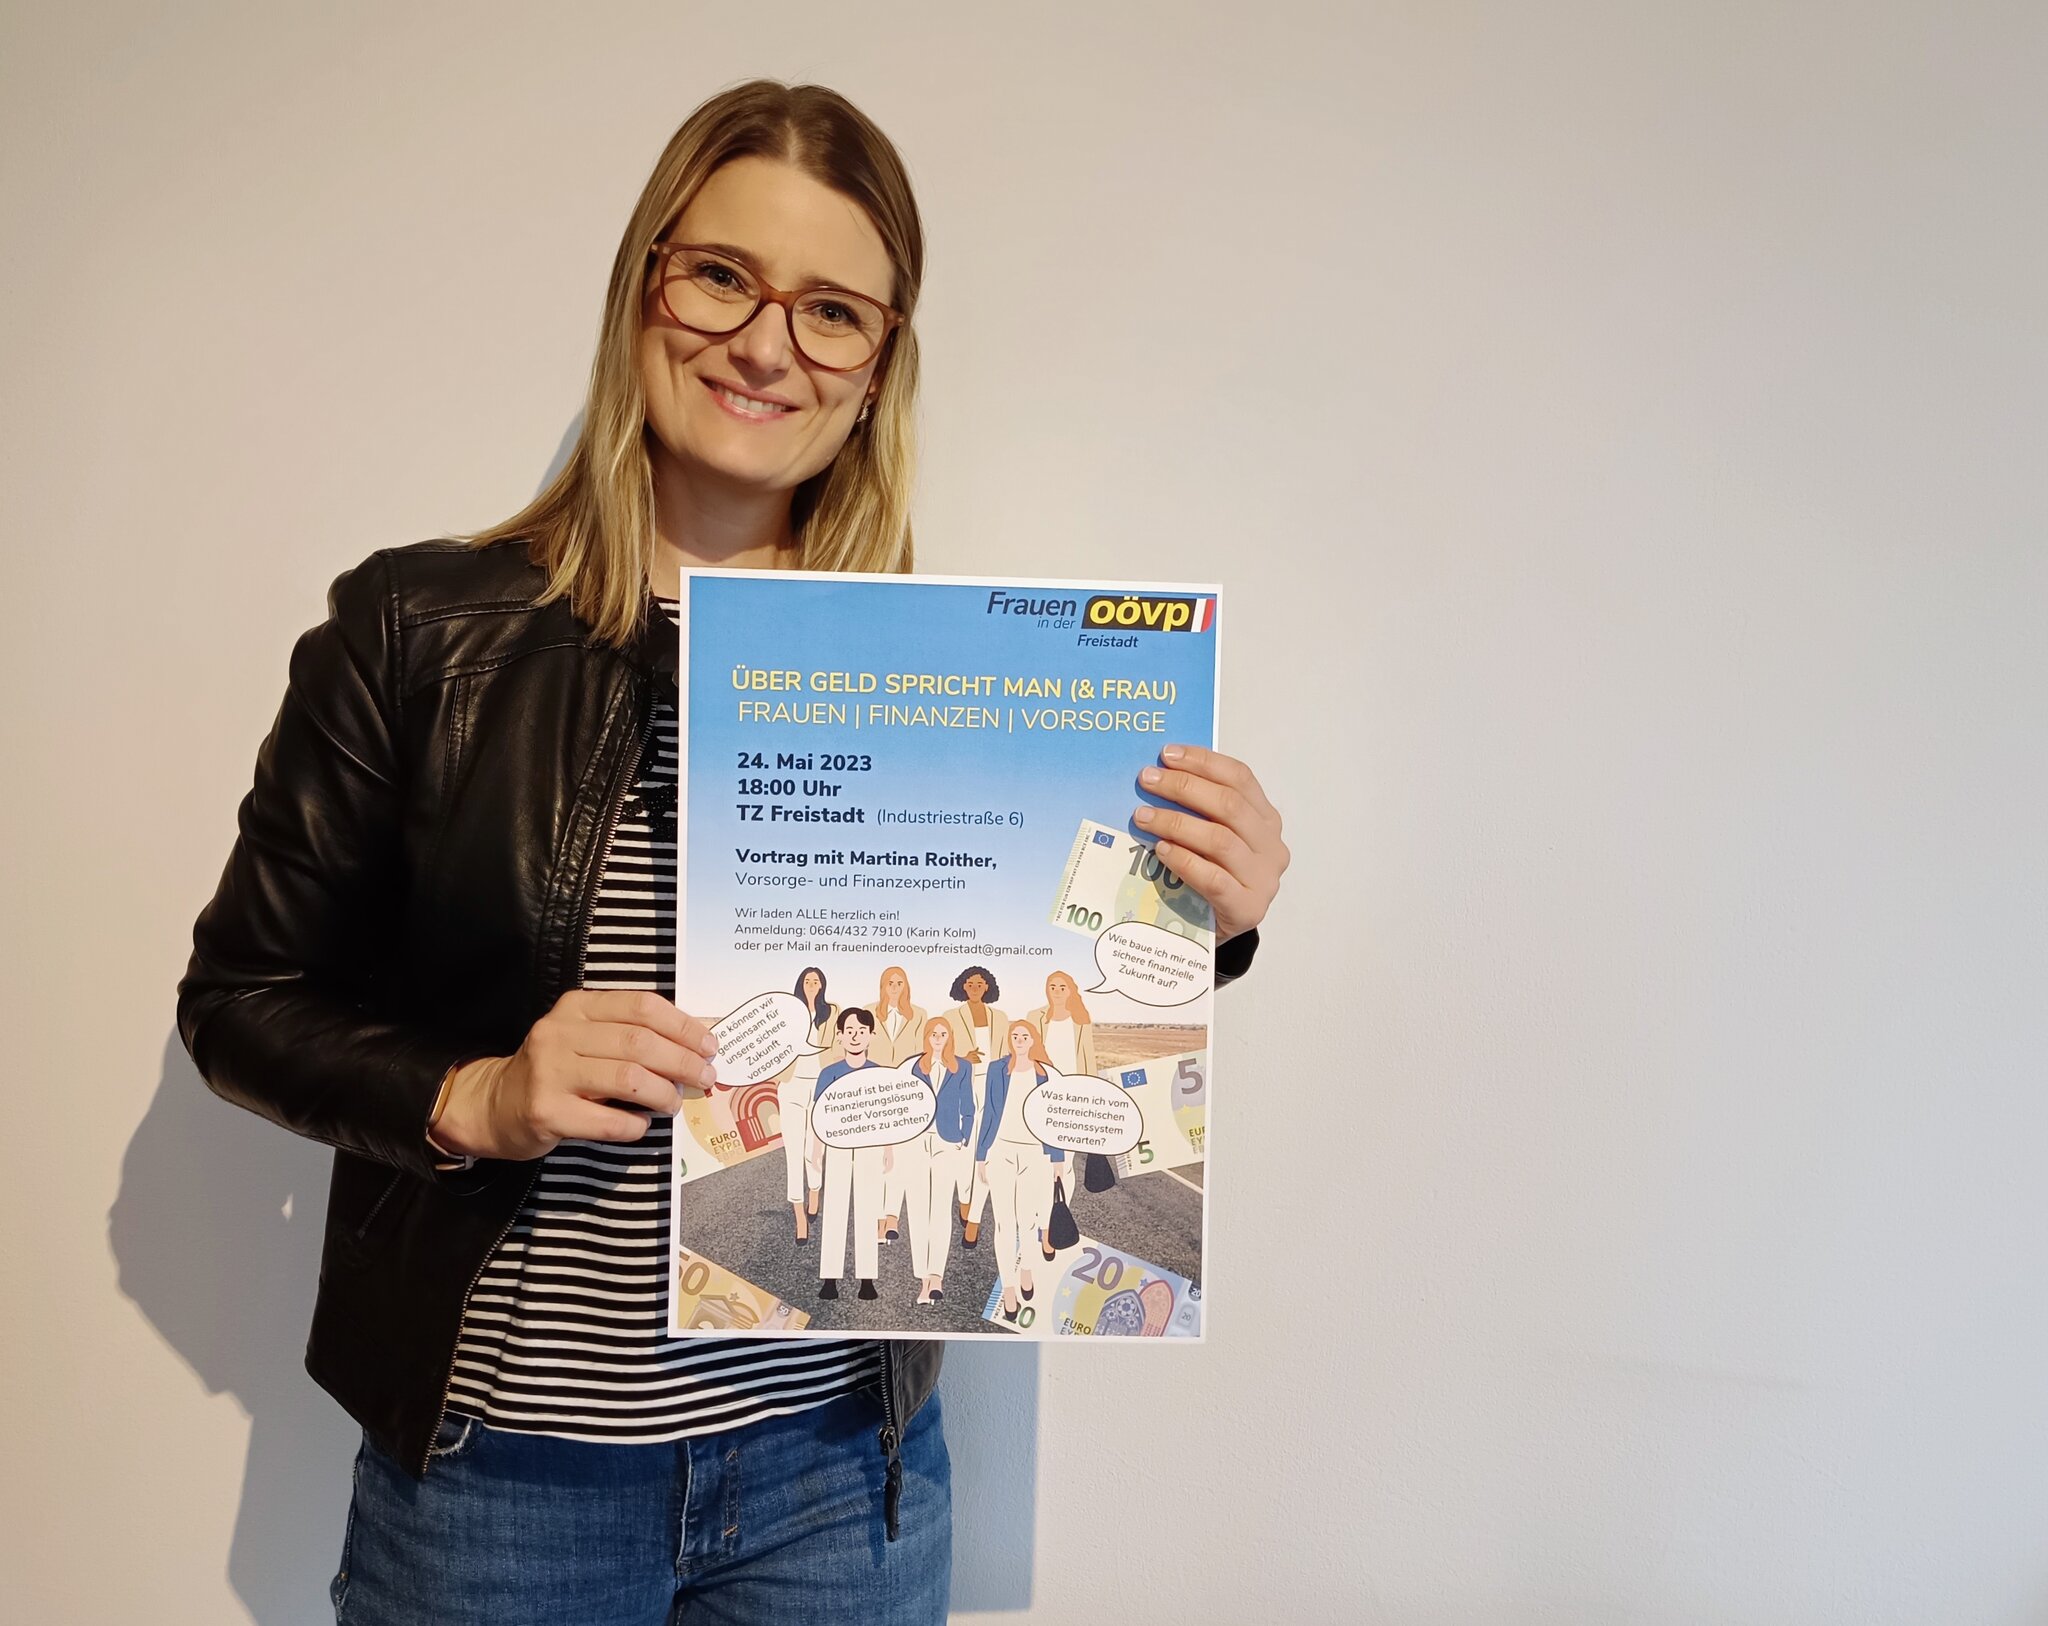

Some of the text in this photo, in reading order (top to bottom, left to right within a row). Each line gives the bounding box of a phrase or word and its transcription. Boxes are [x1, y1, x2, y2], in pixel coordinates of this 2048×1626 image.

[987, 591, 1077, 616] Frauen
[1089, 596, 1190, 631] oövp
[1037, 617, 1076, 629] in der
[1077, 634, 1139, 647] Freistadt
[732, 665, 1177, 705] ÜBER GELD SPRICHT MAN (& FRAU)
[738, 701, 846, 724] FRAUEN
[869, 704, 999, 729] FINANZEN
[1021, 709, 1166, 732] VORSORGE
[737, 752, 872, 771] 24. Mai 2023
[738, 779, 842, 797] 18:00 Uhr
[737, 805, 1024, 828] TZ Freistadt (Industriestraße 6)
[735, 849, 997, 870] Vortrag mit Martina Roither,
[735, 872, 966, 891] Vorsorge- und Finanzexpertin
[735, 908, 900, 921] Wir laden ALLE herzlich ein!
[1066, 904, 1102, 931] 100
[734, 924, 976, 940] Anmeldung: 0664/432 7910 (Karin Kolm)
[734, 941, 1053, 957] oder per Mail an fraueninderooevpfreistadt@gmail.com
[1108, 932, 1207, 971] Wie baue ich mir eine
[1112, 950, 1194, 981] sichere finanzielle
[1119, 964, 1178, 989] Zukunft auf?
[726, 1008, 759, 1032] können
[759, 997, 774, 1010] wir
[718, 1009, 779, 1056] gemeinsam für
[725, 1020, 786, 1064] unsere sichere
[745, 1040, 781, 1066] Zukunft
[747, 1044, 794, 1080] vorsorgen?
[1178, 1058, 1203, 1094] 5
[825, 1087, 862, 1101] Worauf
[878, 1083, 893, 1092] bei
[896, 1080, 919, 1090] einer
[1041, 1090, 1129, 1108] Was kann ich vom
[824, 1092, 924, 1113] Finanzierungslösung
[1047, 1104, 1125, 1121] österreichischen
[826, 1113, 930, 1138] besonders zu achten?
[841, 1106, 909, 1124] oder Vorsorge
[1046, 1118, 1123, 1135] Pensionssystem
[710, 1130, 737, 1146] EURO
[1057, 1134, 1106, 1147] erwarten?
[1138, 1140, 1154, 1164] 5
[1072, 1247, 1124, 1290] 20
[1064, 1318, 1091, 1335] EURO
